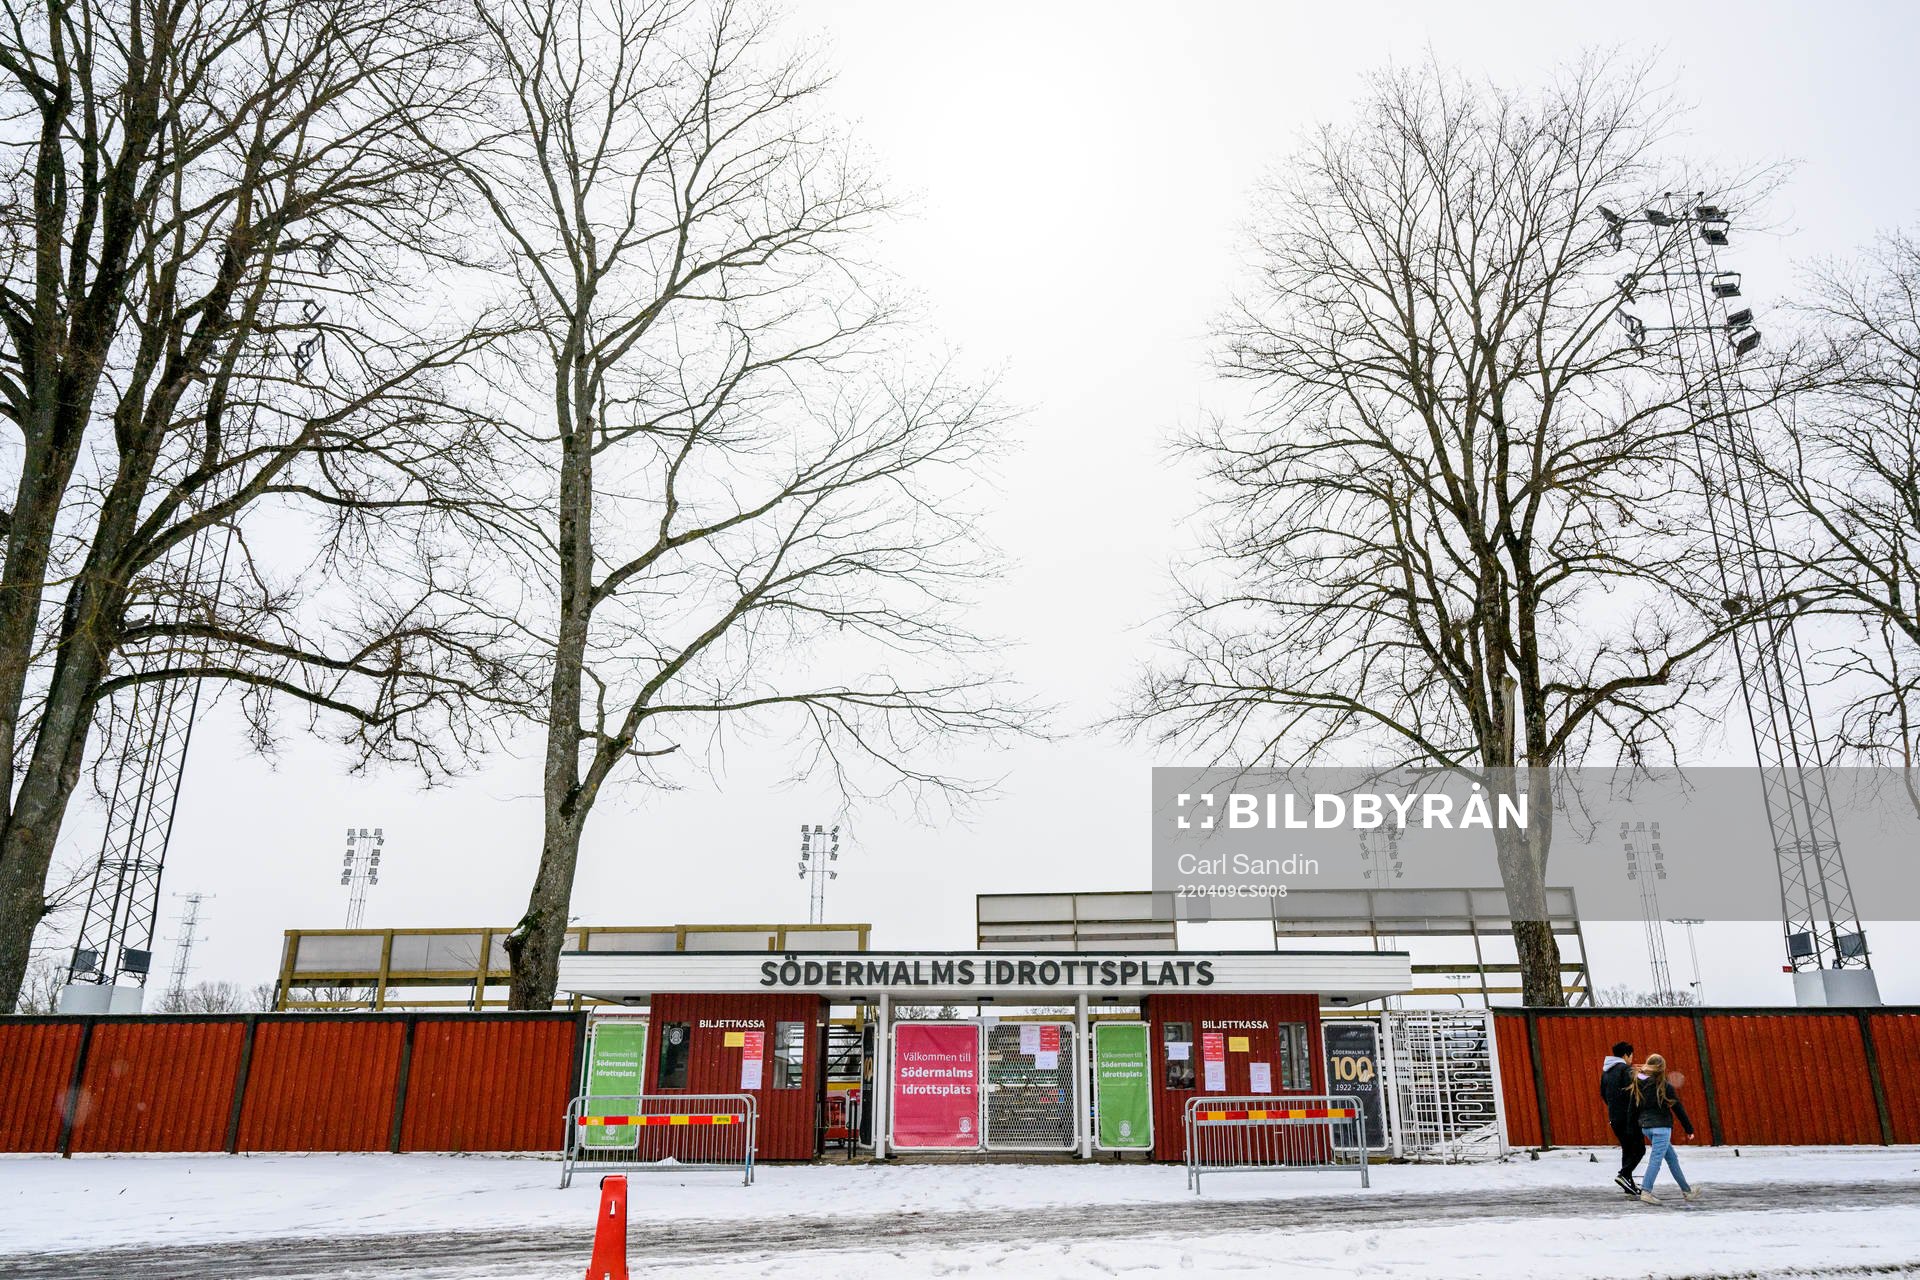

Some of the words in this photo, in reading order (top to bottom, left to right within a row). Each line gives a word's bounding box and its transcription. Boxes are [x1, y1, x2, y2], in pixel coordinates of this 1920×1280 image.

[759, 953, 976, 987] SÖDERMALMS
[985, 959, 1215, 986] IDROTTSPLATS
[699, 1019, 766, 1028] BILJETTKASSA
[1202, 1020, 1269, 1029] BILJETTKASSA
[903, 1052, 957, 1062] Välkommen
[959, 1052, 971, 1062] till
[1101, 1060, 1144, 1068] Södermalms
[901, 1067, 974, 1078] Södermalms
[1330, 1056, 1374, 1082] 100
[1102, 1070, 1143, 1078] Idrottsplats
[902, 1083, 972, 1097] Idrottsplats
[1335, 1083, 1352, 1091] 1922
[1356, 1083, 1373, 1091] 2022
